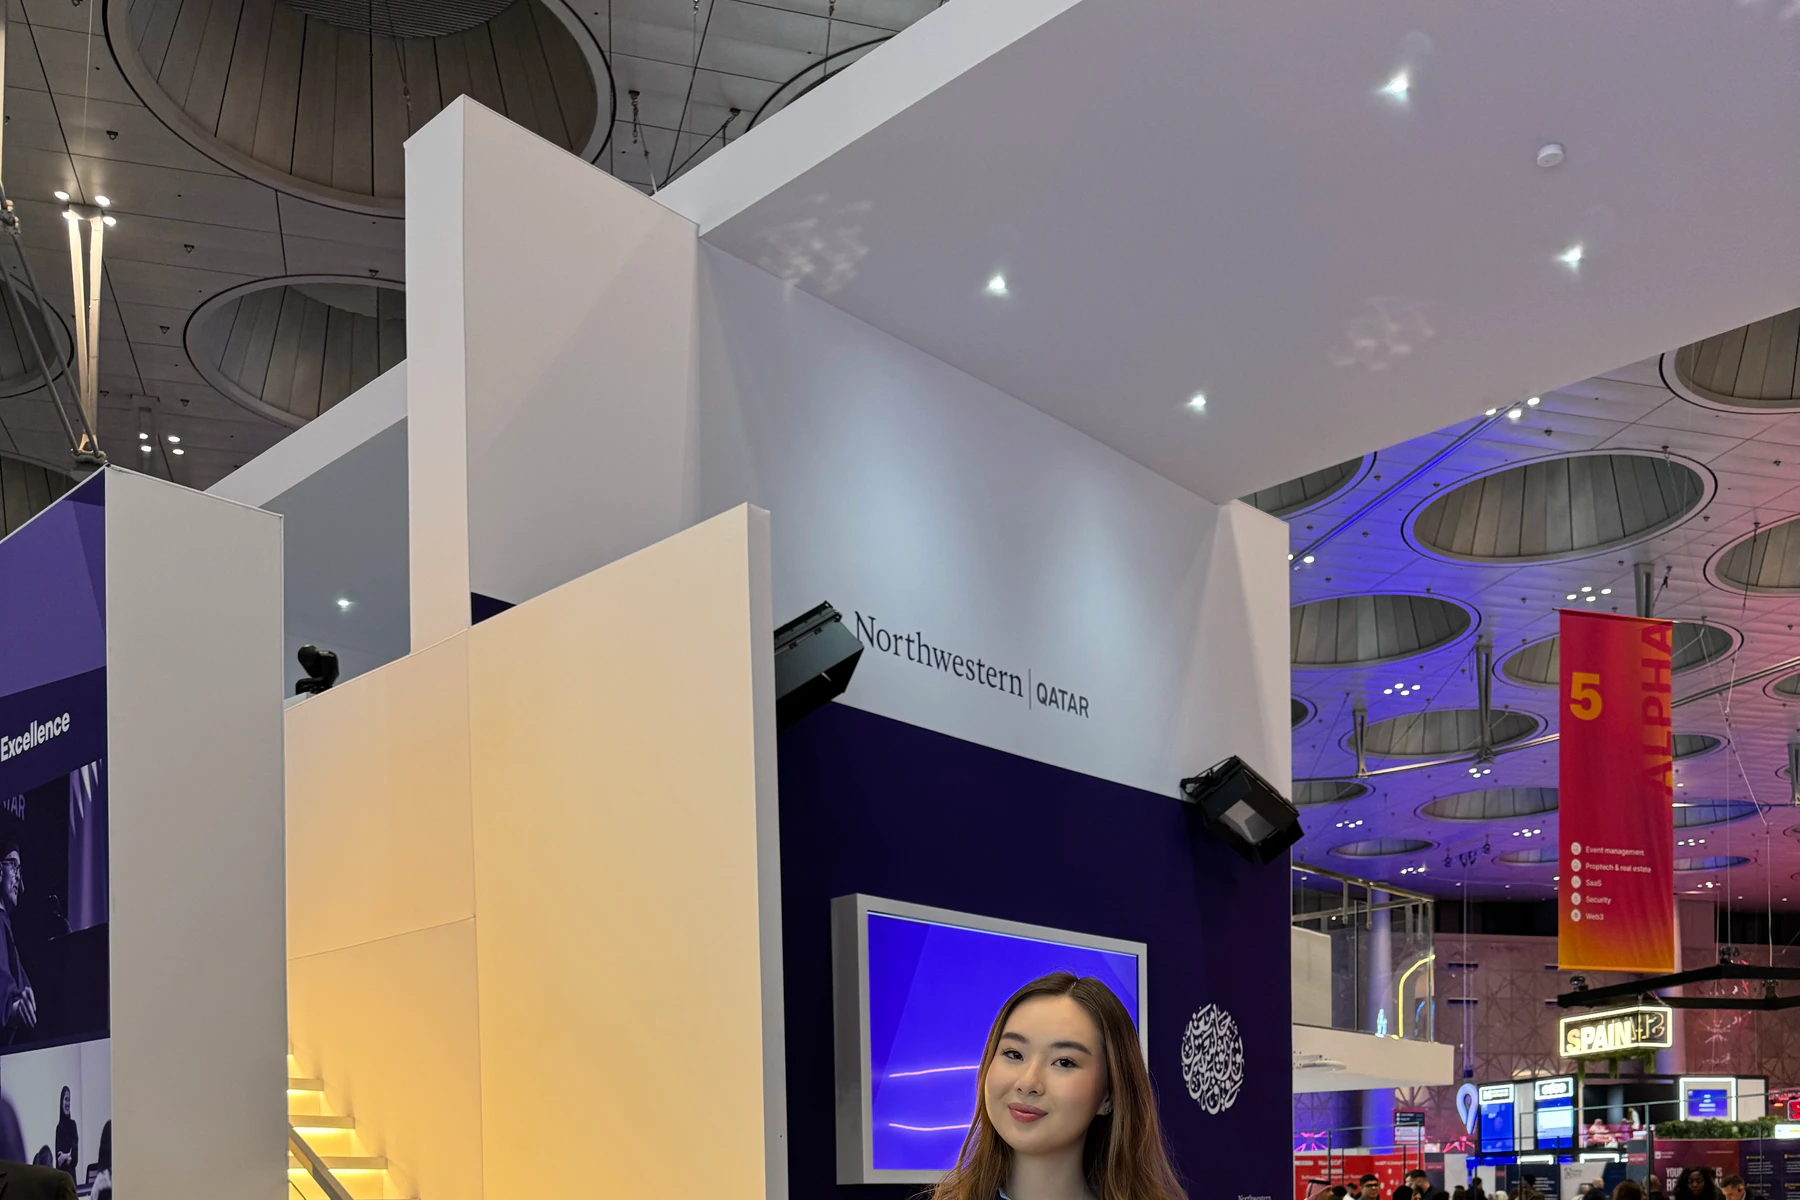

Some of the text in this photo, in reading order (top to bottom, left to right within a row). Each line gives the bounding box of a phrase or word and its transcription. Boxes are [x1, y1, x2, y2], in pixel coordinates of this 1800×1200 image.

[855, 610, 1089, 718] Northwestern QATAR
[1569, 671, 1603, 721] 5
[1642, 621, 1673, 799] ALPHA
[1, 712, 70, 762] Excellence
[1585, 845, 1645, 857] Event management
[1585, 862, 1614, 872] Proptech
[1614, 863, 1620, 872] &
[1632, 866, 1652, 874] estate
[1585, 878, 1602, 887] SaaS
[1585, 895, 1612, 905] Security
[1585, 912, 1605, 921] Web3
[1566, 1020, 1632, 1053] SPAIN
